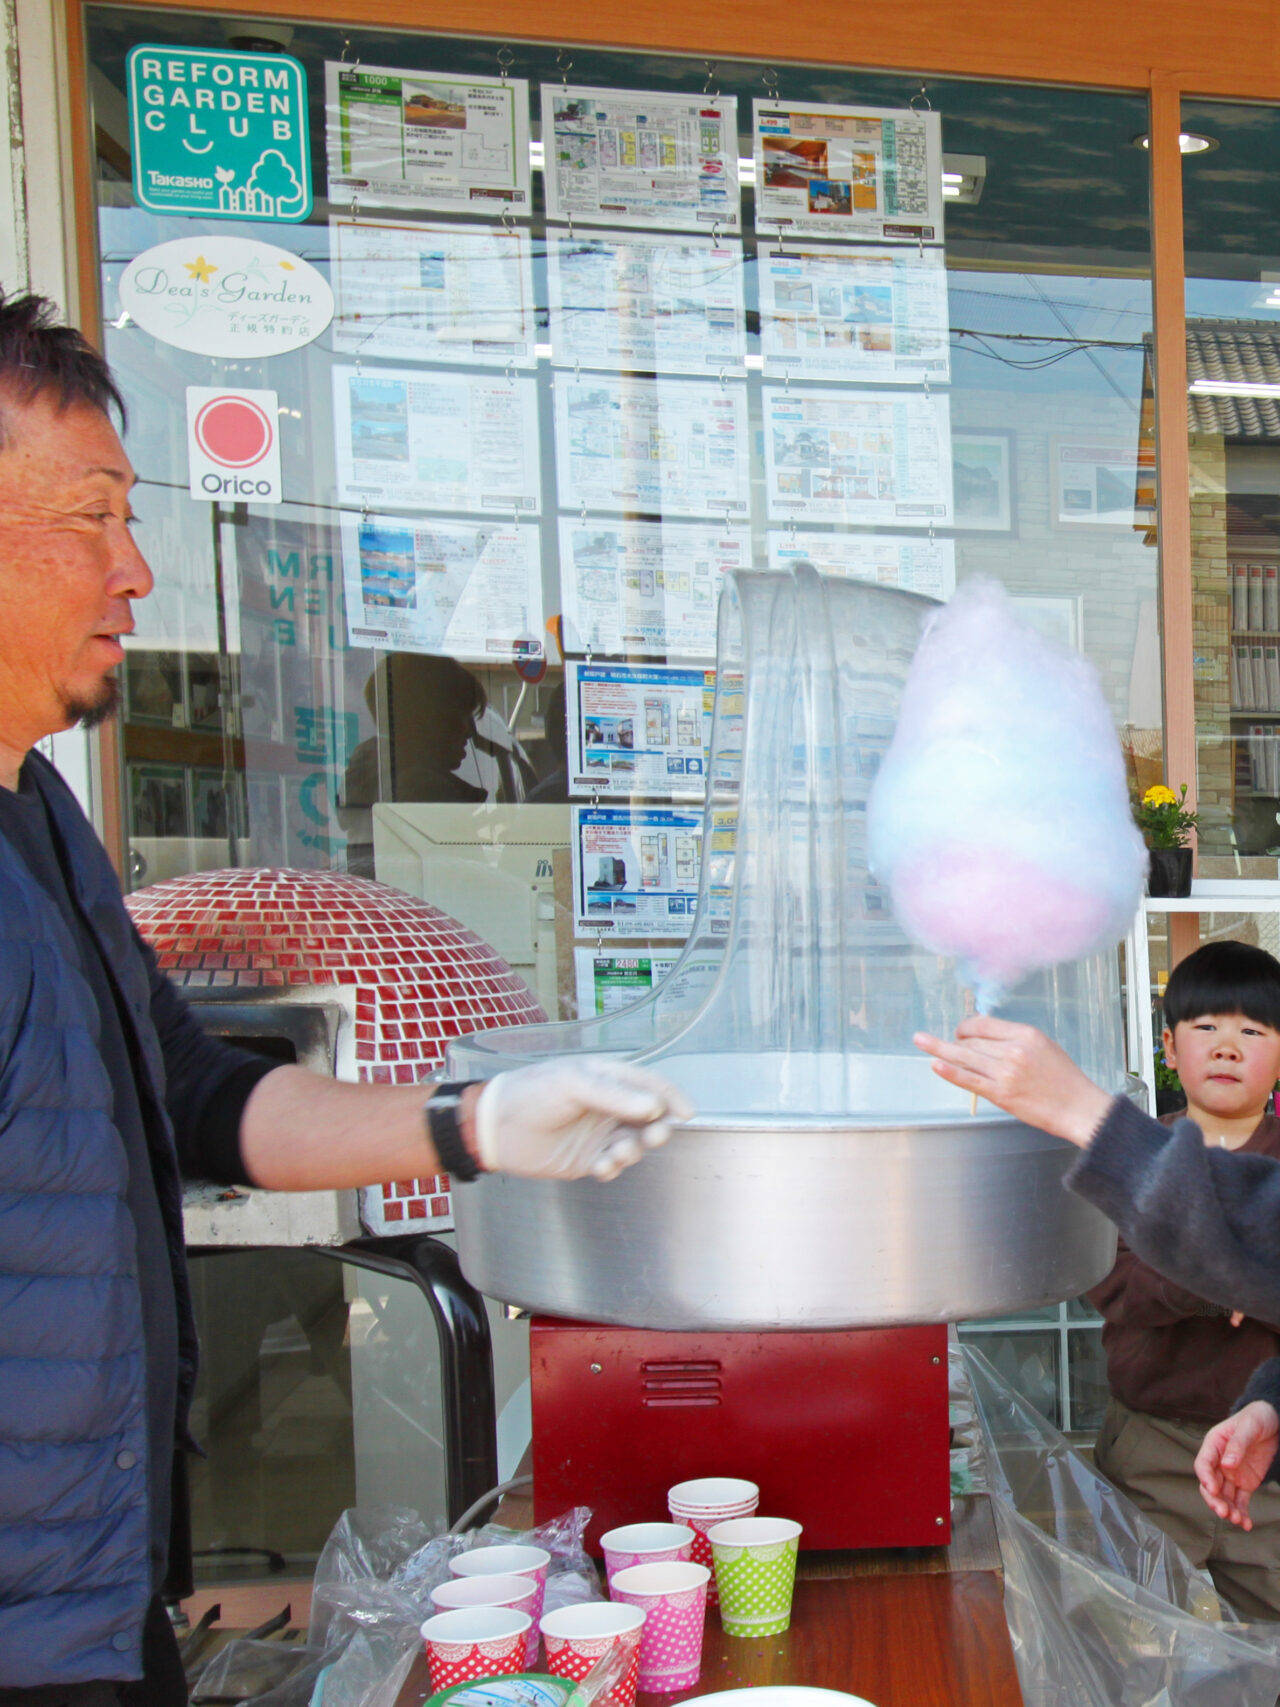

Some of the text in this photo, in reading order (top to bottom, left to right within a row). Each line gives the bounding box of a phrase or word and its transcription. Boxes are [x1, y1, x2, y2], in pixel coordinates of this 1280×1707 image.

[141, 58, 290, 90] REFORM
[142, 84, 291, 116] GARDEN
[217, 271, 313, 305] Garden
[229, 311, 311, 325] ディーズガーデン
[229, 323, 311, 337] 正規特約店
[200, 472, 272, 497] Orico
